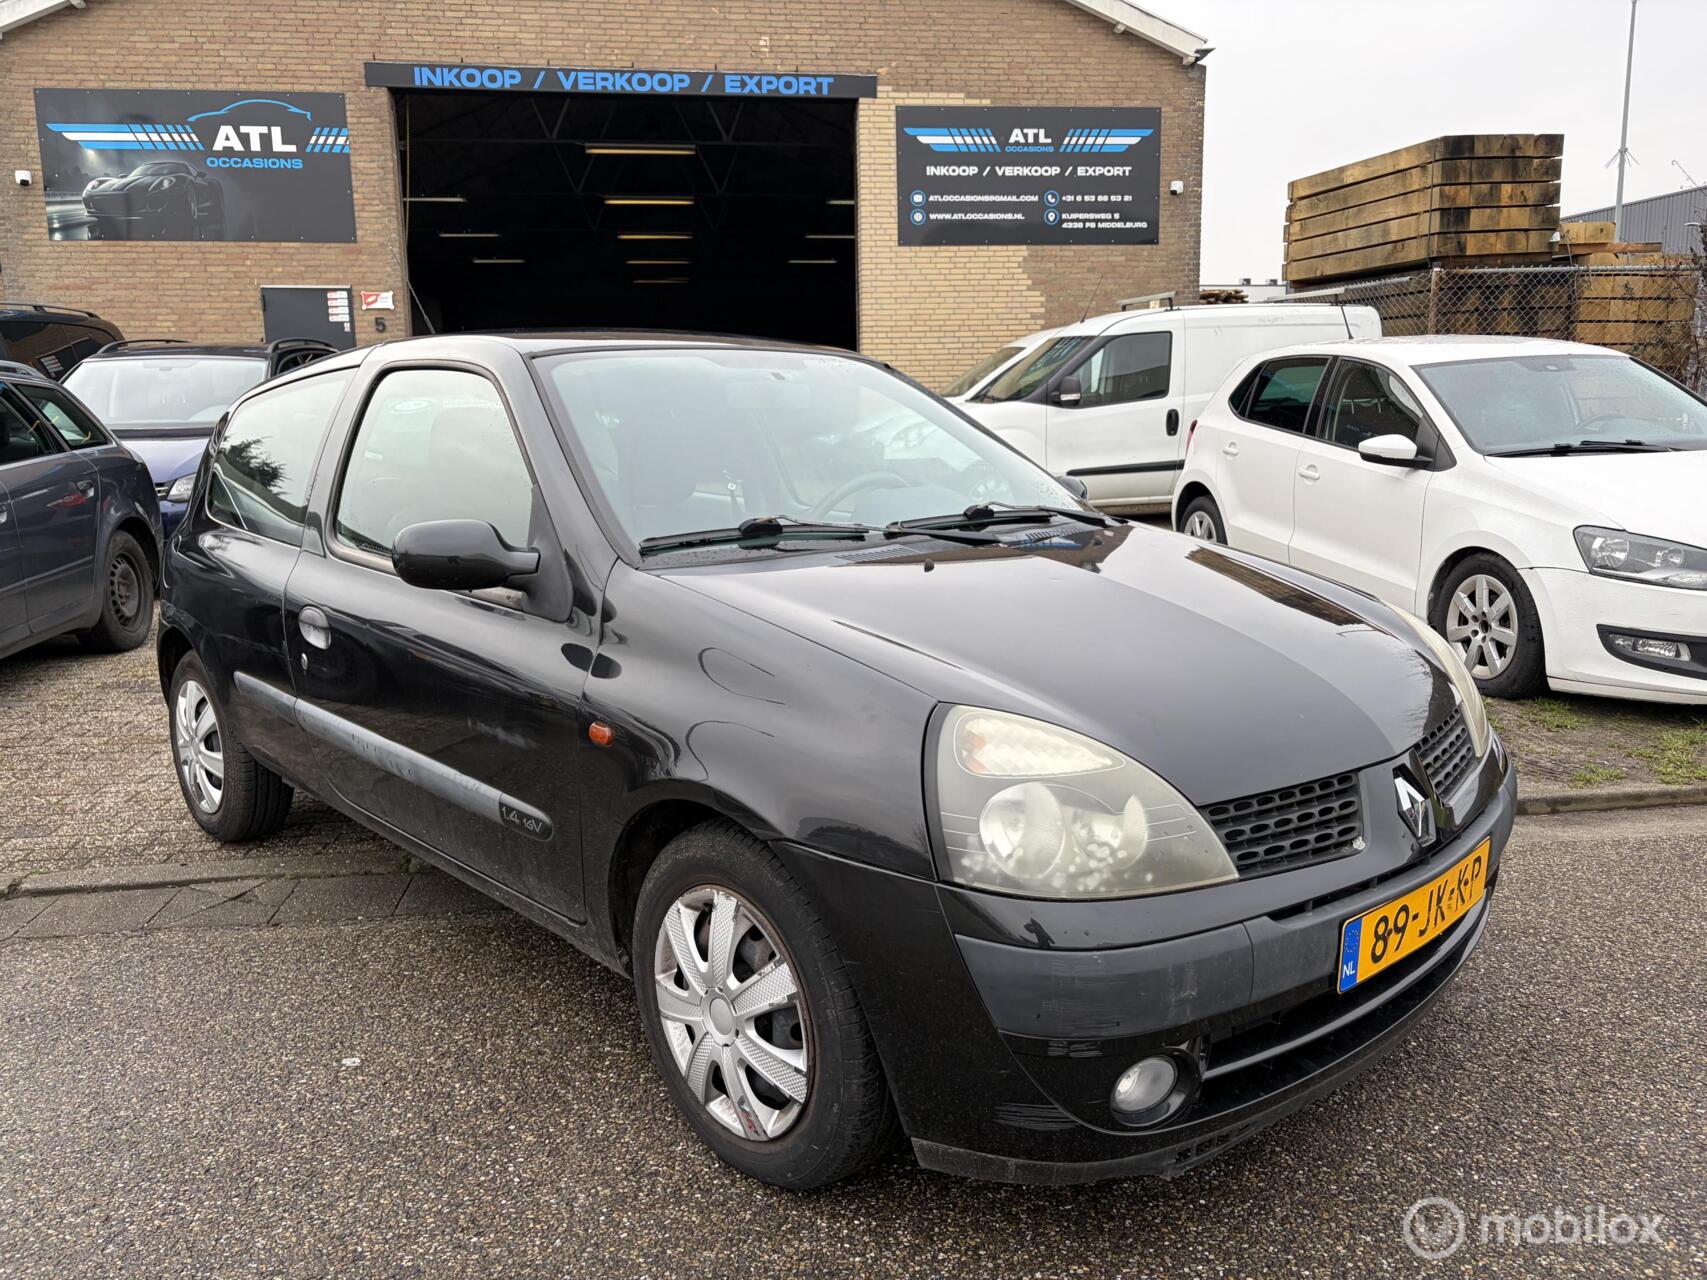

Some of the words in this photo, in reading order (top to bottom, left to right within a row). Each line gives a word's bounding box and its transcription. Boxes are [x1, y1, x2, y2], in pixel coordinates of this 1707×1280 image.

[413, 66, 522, 89] INKOOP
[533, 70, 546, 89] /
[557, 71, 691, 93] VERKOOP
[701, 74, 713, 93] /
[724, 75, 834, 96] EXPORT
[212, 124, 297, 153] ATL
[1008, 128, 1052, 144] ATL
[1005, 145, 1055, 153] OCCASIONS
[206, 157, 304, 169] OCCASIONS
[926, 165, 979, 177] INKOOP
[982, 165, 991, 177] /
[995, 165, 1061, 177] VERKOOP
[1064, 166, 1073, 177] /
[1077, 166, 1133, 177] EXPORT
[375, 317, 386, 332] 5
[502, 806, 520, 824] 1.4
[523, 818, 542, 832] 16V
[1370, 855, 1482, 964] 89-JK-KP
[1342, 960, 1356, 979] NL
